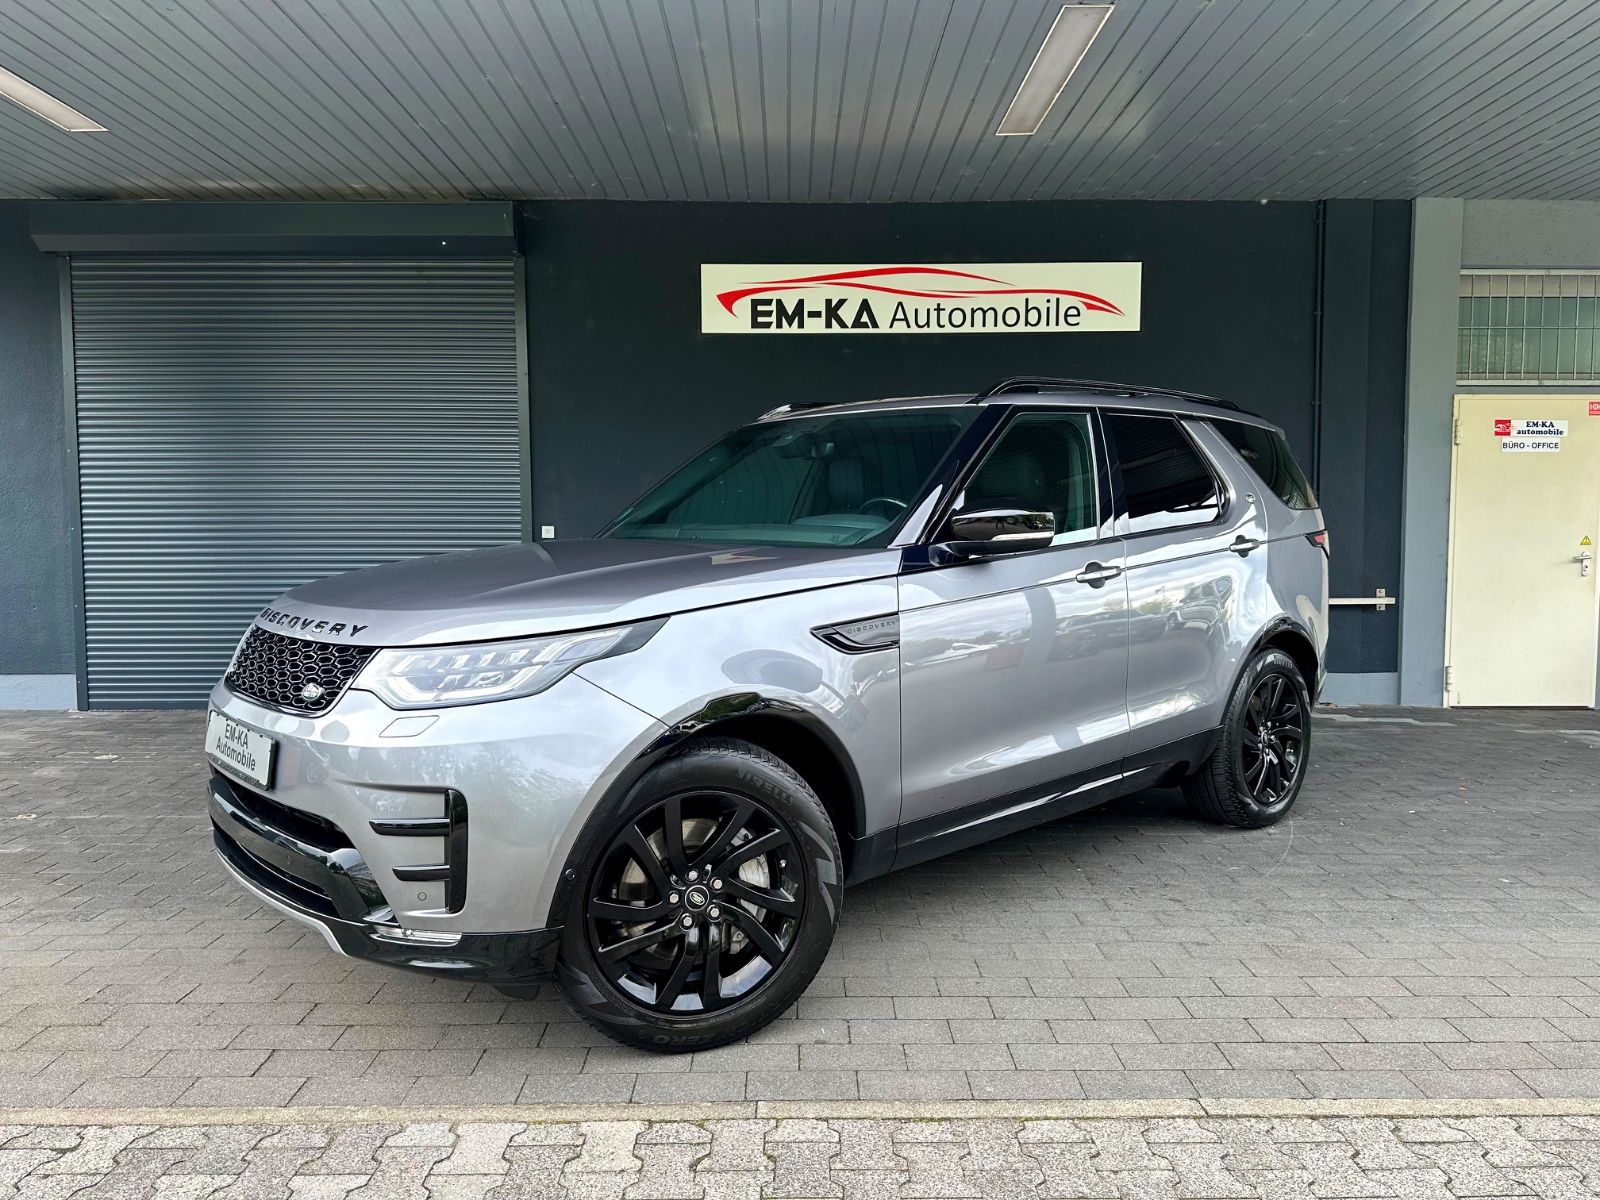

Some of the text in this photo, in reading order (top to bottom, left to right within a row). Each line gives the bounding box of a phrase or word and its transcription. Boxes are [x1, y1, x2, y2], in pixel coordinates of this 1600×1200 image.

[750, 298, 1081, 329] EM-KA Automobile
[1502, 441, 1525, 449] BÜRO
[260, 607, 368, 637] DISCOVERY
[847, 621, 896, 634] DISCOVERY
[224, 723, 249, 750] EM-KA
[215, 738, 257, 772] Automobile
